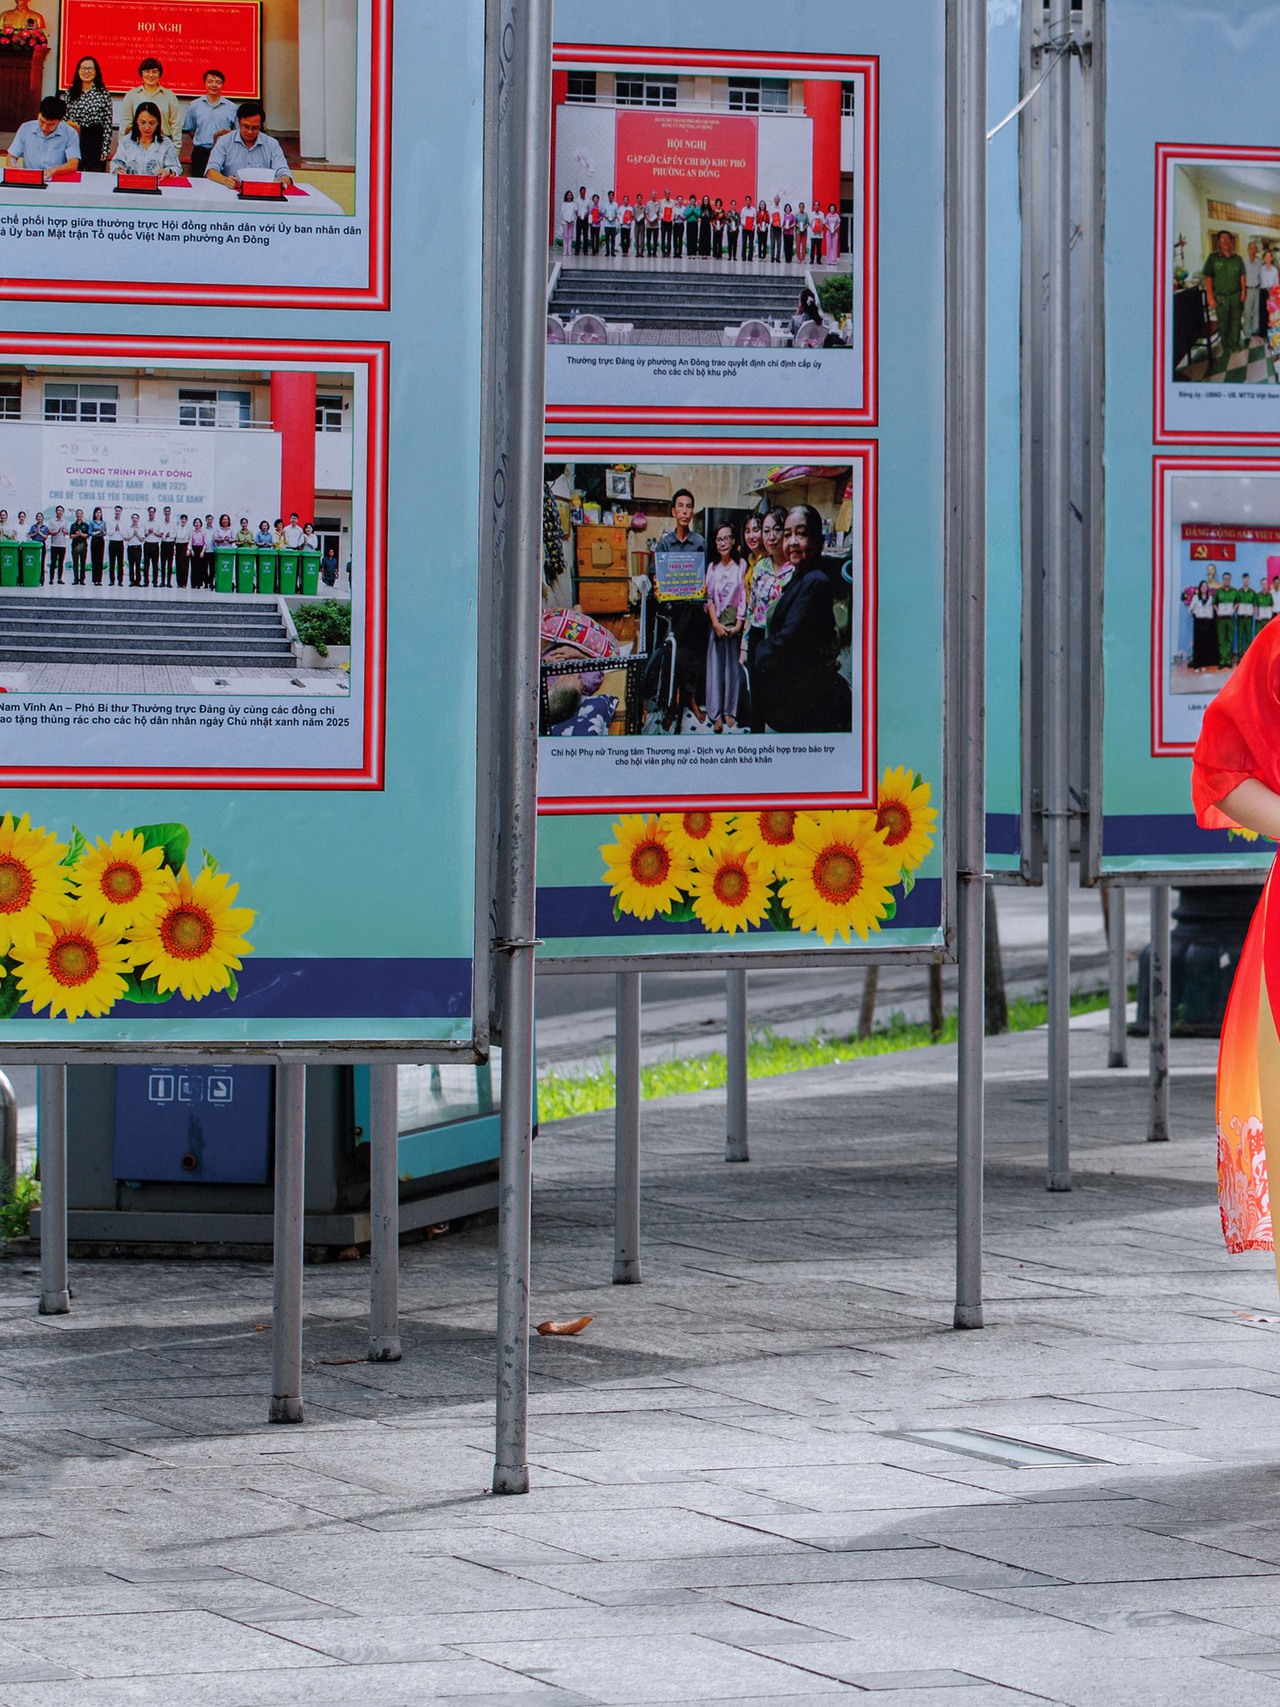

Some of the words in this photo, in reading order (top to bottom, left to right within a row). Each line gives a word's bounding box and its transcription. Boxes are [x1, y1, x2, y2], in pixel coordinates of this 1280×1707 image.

[137, 21, 155, 33] HỘI
[158, 23, 182, 35] NGHỊ
[667, 138, 683, 150] HỘI
[685, 140, 707, 152] NGHỊ
[686, 168, 697, 177] AN
[1, 213, 19, 225] chế
[22, 214, 45, 227] phối
[47, 216, 68, 228] hợp
[71, 217, 94, 228] giữa
[97, 218, 135, 230] thường
[138, 220, 159, 231] trực
[162, 220, 179, 232] Hội
[181, 219, 207, 232] đồng
[210, 222, 234, 231] nhân
[238, 223, 256, 232] dân
[259, 223, 275, 232] với
[278, 222, 291, 235] Ủy
[294, 224, 313, 234] ban
[315, 225, 340, 234] nhân
[343, 226, 362, 235] dân
[0, 226, 6, 236] à
[9, 225, 23, 239] Ủy
[26, 228, 45, 237] ban
[47, 228, 66, 240] Mặt
[68, 229, 89, 240] trận
[92, 228, 105, 240] Tổ
[107, 229, 133, 241] quốc
[136, 231, 155, 242] Việt
[157, 232, 180, 241] Nam
[183, 233, 224, 245] phường
[226, 234, 240, 243] An
[243, 235, 270, 246] Đông
[567, 356, 597, 366] Thường
[598, 357, 614, 366] trực
[615, 356, 635, 367] Đảng
[636, 357, 646, 367] ủy
[647, 358, 677, 367] phường
[678, 358, 689, 366] An
[690, 358, 710, 368] Đông
[711, 359, 727, 367] trao
[728, 357, 748, 368] quyết
[749, 359, 766, 368] định
[780, 359, 797, 369] định
[798, 358, 812, 369] cấp
[813, 359, 822, 369] ủy
[653, 367, 667, 376] cho
[668, 367, 682, 376] các
[696, 368, 706, 377] bộ
[707, 368, 721, 376] khu
[722, 368, 737, 377] phố
[169, 481, 187, 491] 2025
[0, 702, 20, 711] Nam
[23, 702, 46, 712] Vĩnh
[48, 703, 63, 712] An
[75, 703, 95, 712] Phó
[98, 703, 109, 712] Bí
[111, 703, 129, 713] thư
[132, 703, 173, 715] Thường
[175, 704, 197, 716] trực
[199, 704, 226, 715] Đảng
[228, 704, 241, 715] ủy
[243, 705, 269, 716] cùng
[271, 705, 289, 715] các
[291, 704, 317, 717] đồng
[319, 705, 335, 715] chí
[0, 716, 12, 724] ao
[15, 714, 38, 726] tặng
[40, 715, 70, 726] thùng
[73, 715, 89, 725] rác
[92, 715, 111, 725] cho
[113, 715, 131, 725] các
[135, 715, 148, 726] hộ
[150, 716, 169, 725] dân
[171, 716, 197, 726] nhân
[199, 716, 224, 728] ngày
[227, 716, 248, 726] Chủ
[250, 717, 273, 728] nhật
[275, 717, 300, 727] xanh
[302, 718, 324, 727] năm
[326, 717, 350, 727] 2025
[551, 748, 564, 757] Chi
[565, 748, 577, 758] hội
[579, 748, 594, 758] Phụ
[595, 748, 607, 756] nữ
[607, 748, 629, 757] Trung
[630, 748, 645, 756] tâm
[646, 747, 676, 757] Thương
[677, 747, 691, 756] mại
[697, 746, 714, 756] Dịch
[715, 747, 724, 756] vụ
[725, 746, 736, 754] An
[738, 746, 757, 755] Đông
[758, 744, 775, 755] phối
[776, 746, 791, 755] hợp
[823, 746, 836, 754] trợ
